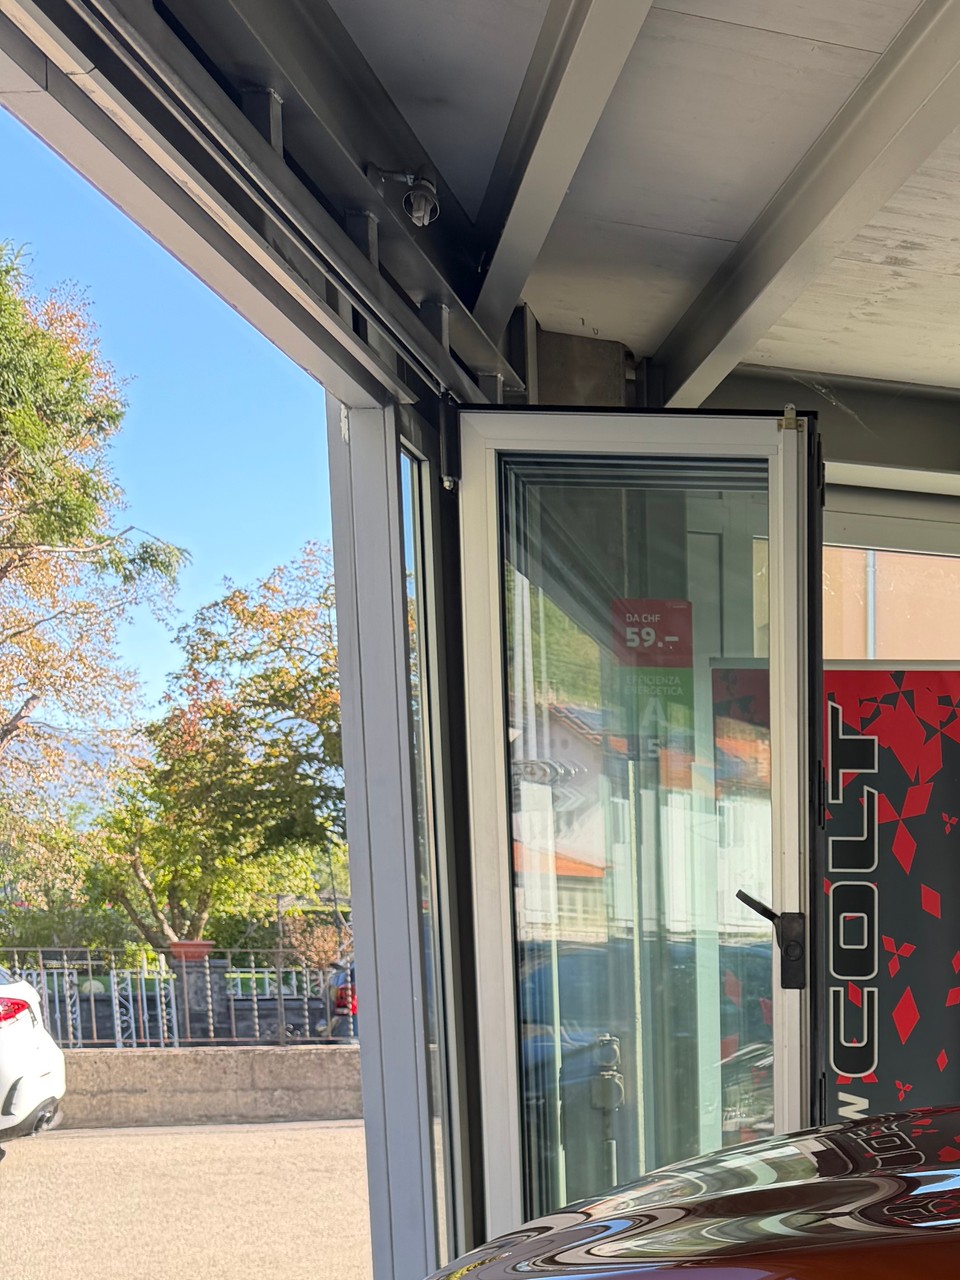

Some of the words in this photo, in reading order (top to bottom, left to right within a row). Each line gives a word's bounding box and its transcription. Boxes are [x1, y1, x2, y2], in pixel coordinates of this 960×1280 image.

[626, 613, 640, 623] DA
[642, 614, 661, 623] CHF
[626, 675, 681, 685] EFFICIENZA
[625, 686, 684, 695] ENERGETICA
[828, 700, 879, 1078] COLT
[836, 1091, 871, 1121] W
